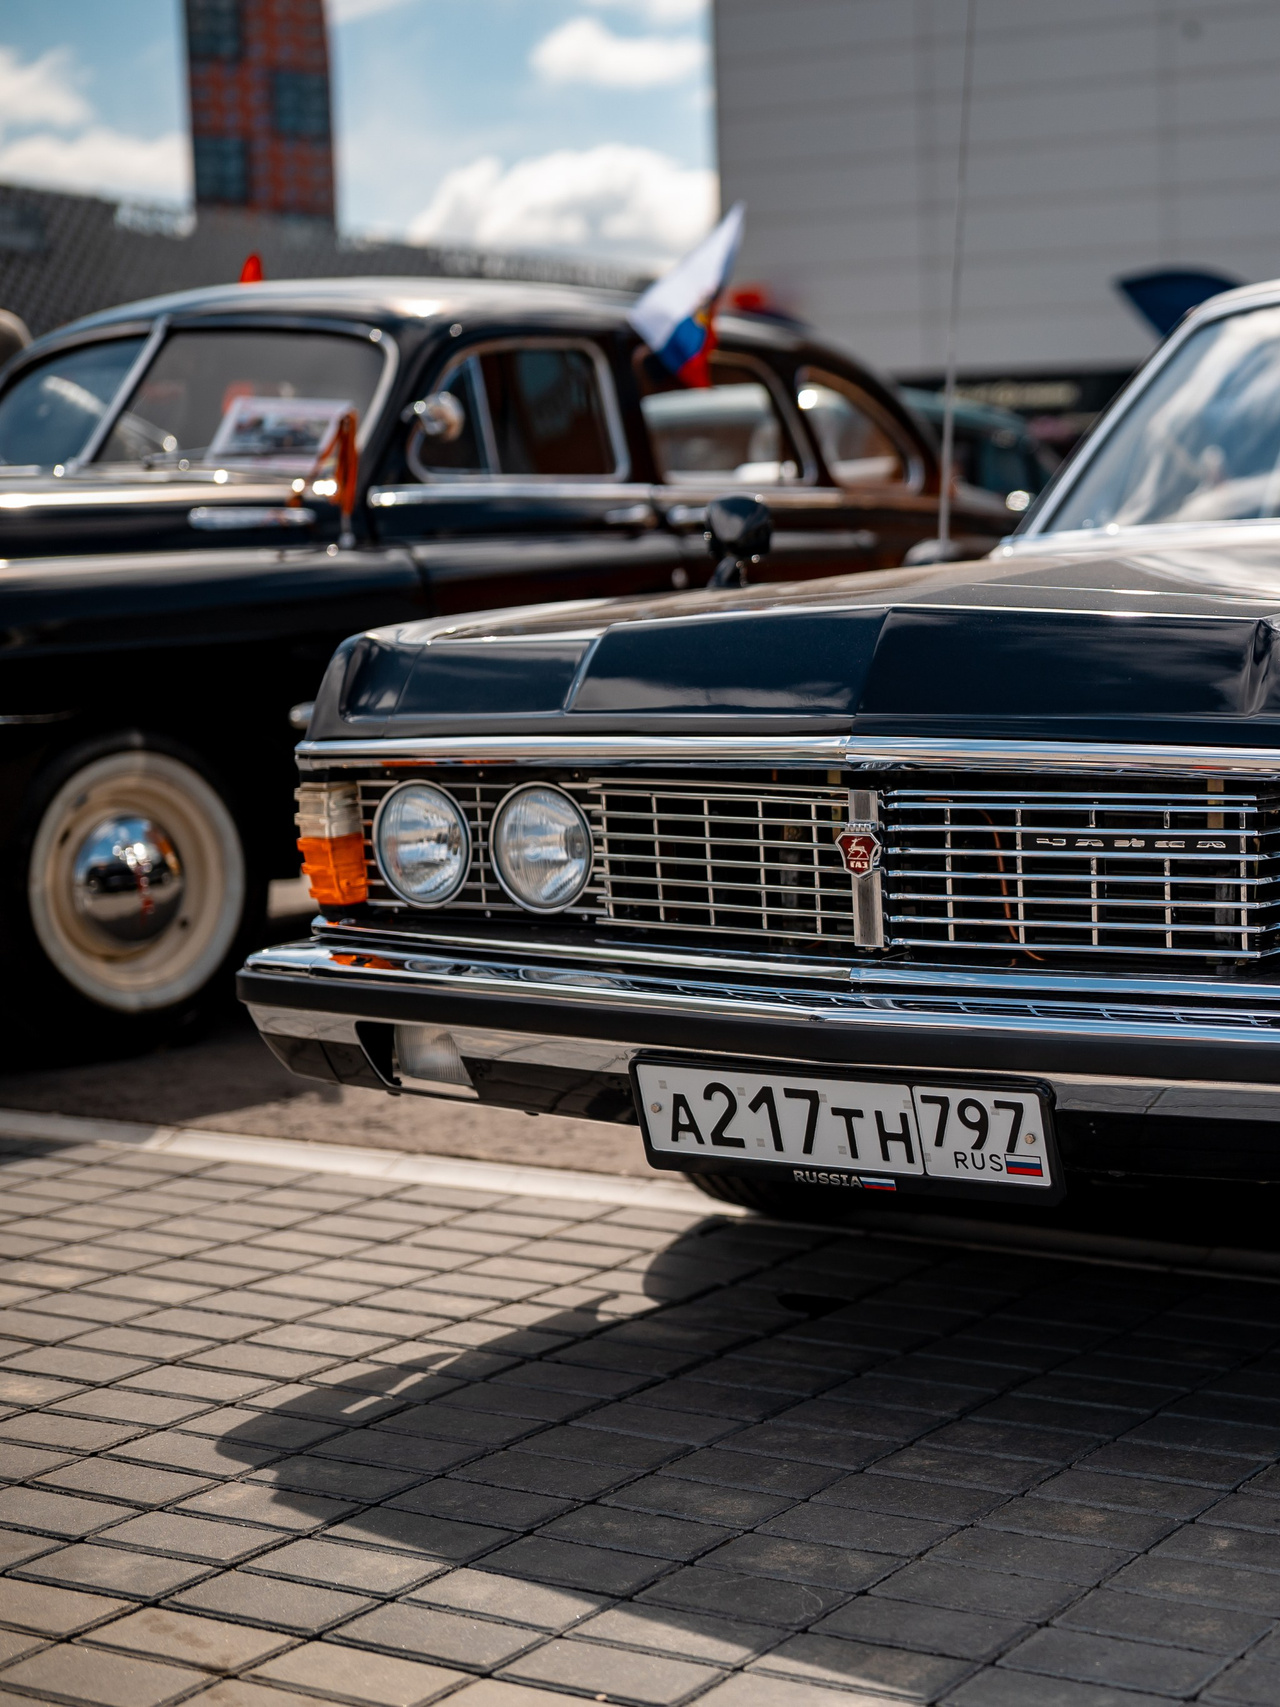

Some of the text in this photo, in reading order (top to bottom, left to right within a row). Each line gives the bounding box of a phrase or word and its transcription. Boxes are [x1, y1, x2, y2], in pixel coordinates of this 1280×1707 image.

[920, 1094, 1024, 1154] 797
[954, 1151, 1003, 1172] RUS
[793, 1169, 862, 1188] RUSSIA
